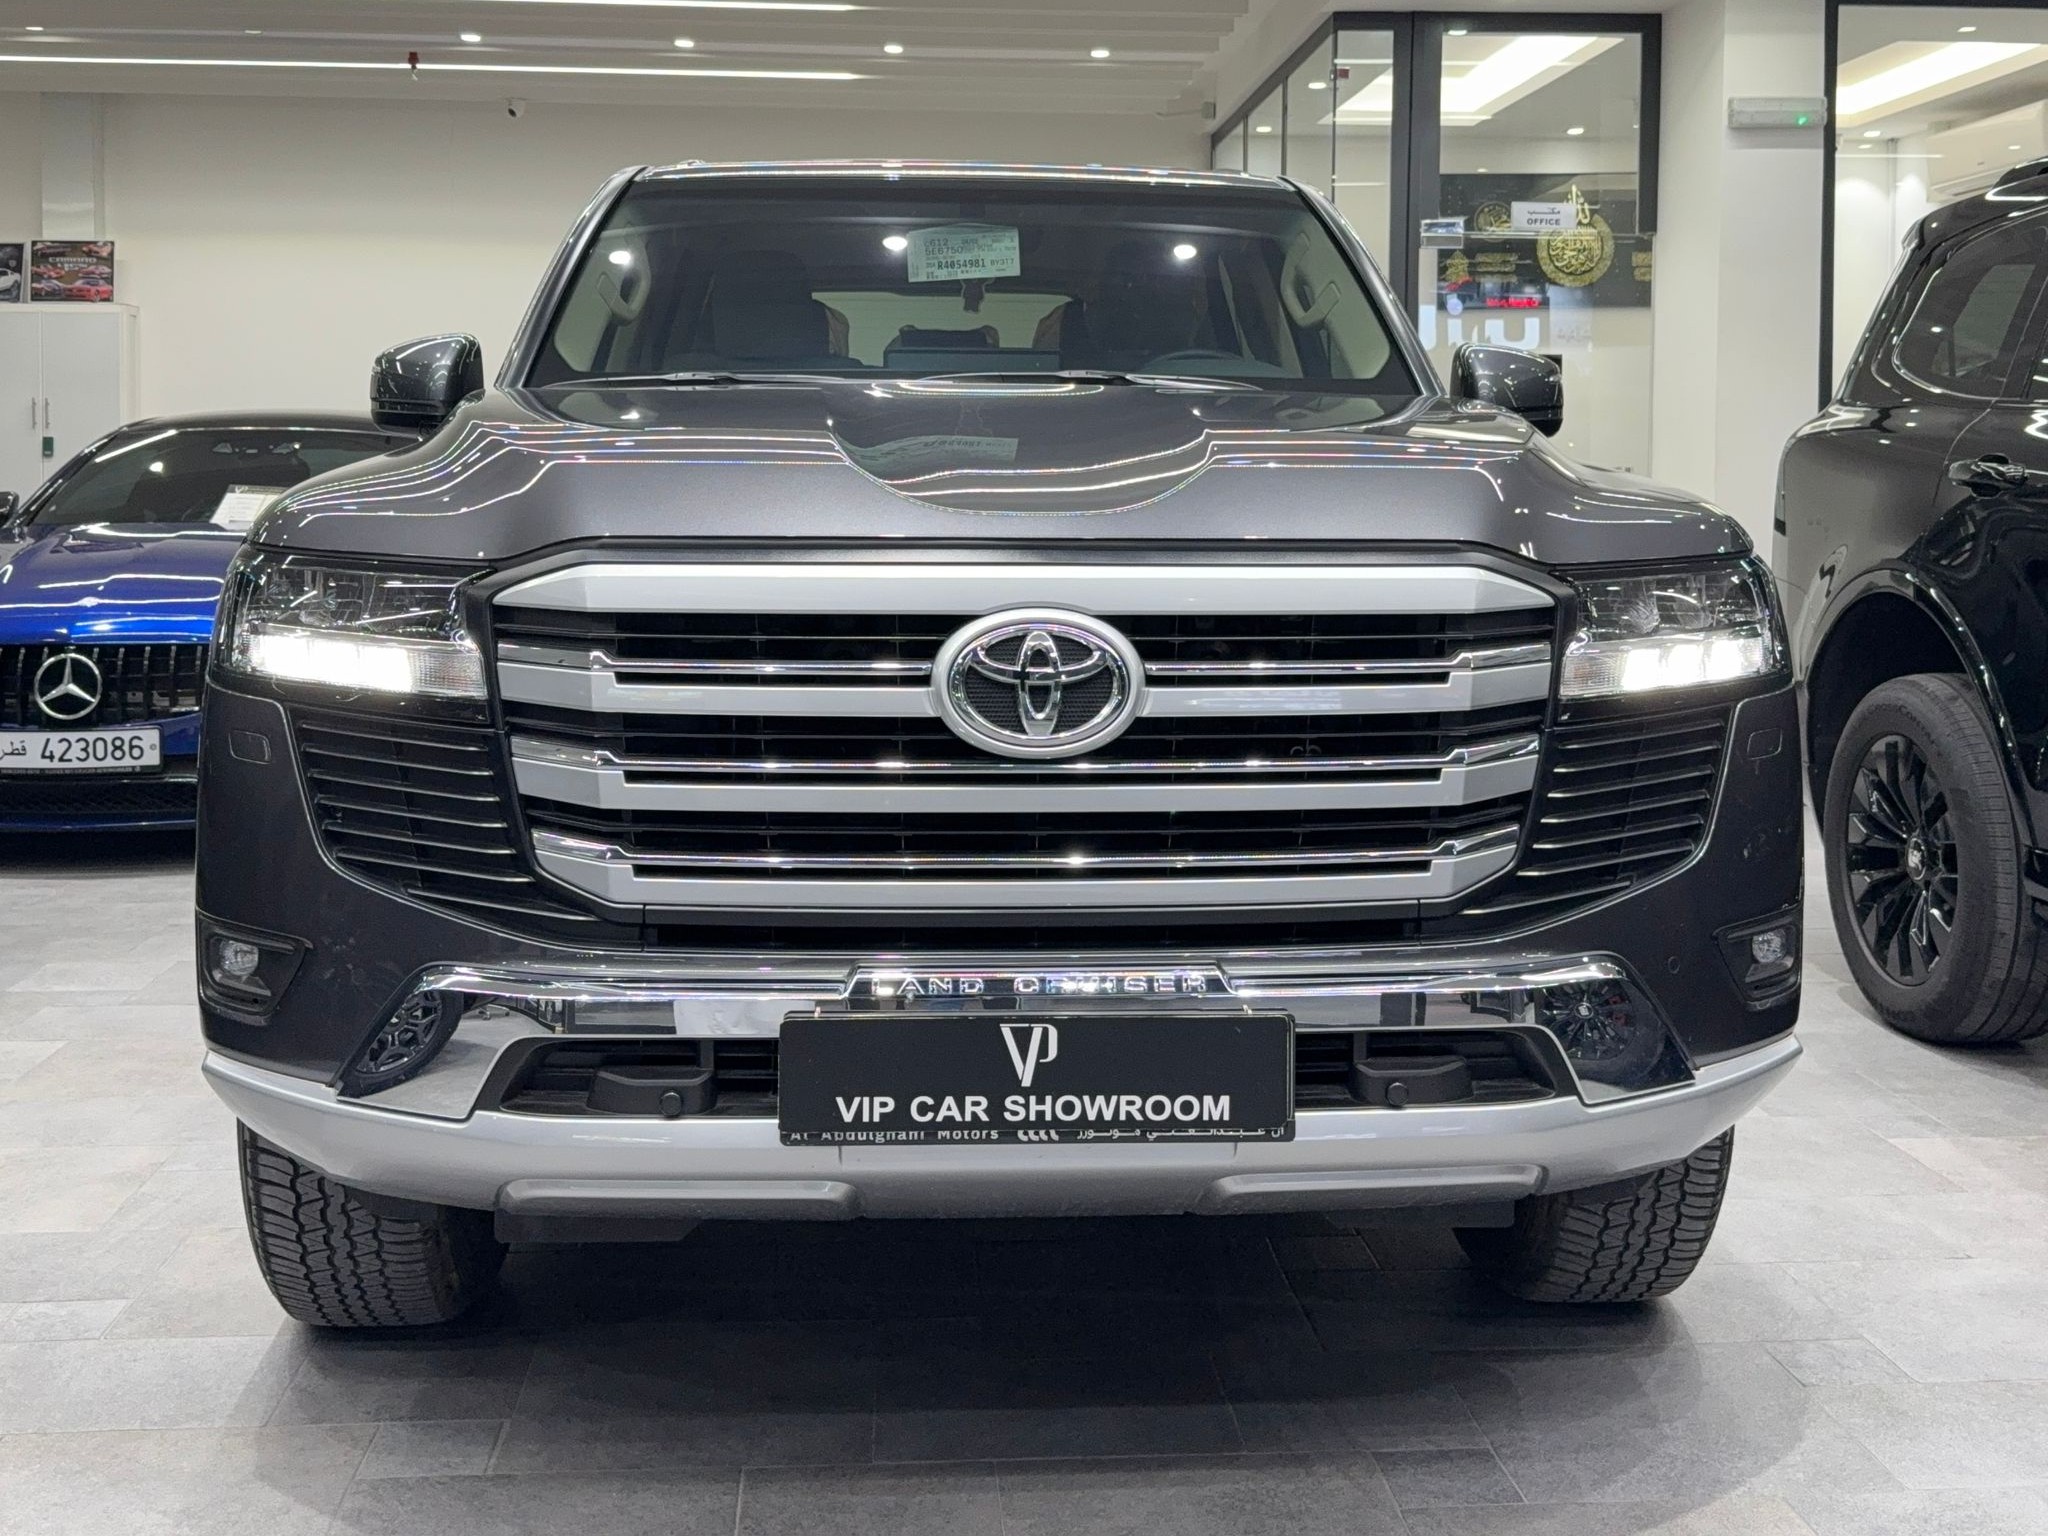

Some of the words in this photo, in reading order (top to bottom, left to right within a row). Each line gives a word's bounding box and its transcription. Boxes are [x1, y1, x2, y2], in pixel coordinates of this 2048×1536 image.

[1526, 218, 1561, 226] OFFICE
[937, 258, 986, 271] R4054981
[40, 735, 145, 763] 423086
[870, 976, 985, 996] LAND
[1013, 975, 1207, 995] CRUISER
[836, 1096, 895, 1123] VIP
[910, 1095, 989, 1123] CAR
[1003, 1094, 1231, 1122] SHOWROOM
[937, 1129, 999, 1141] Motors
